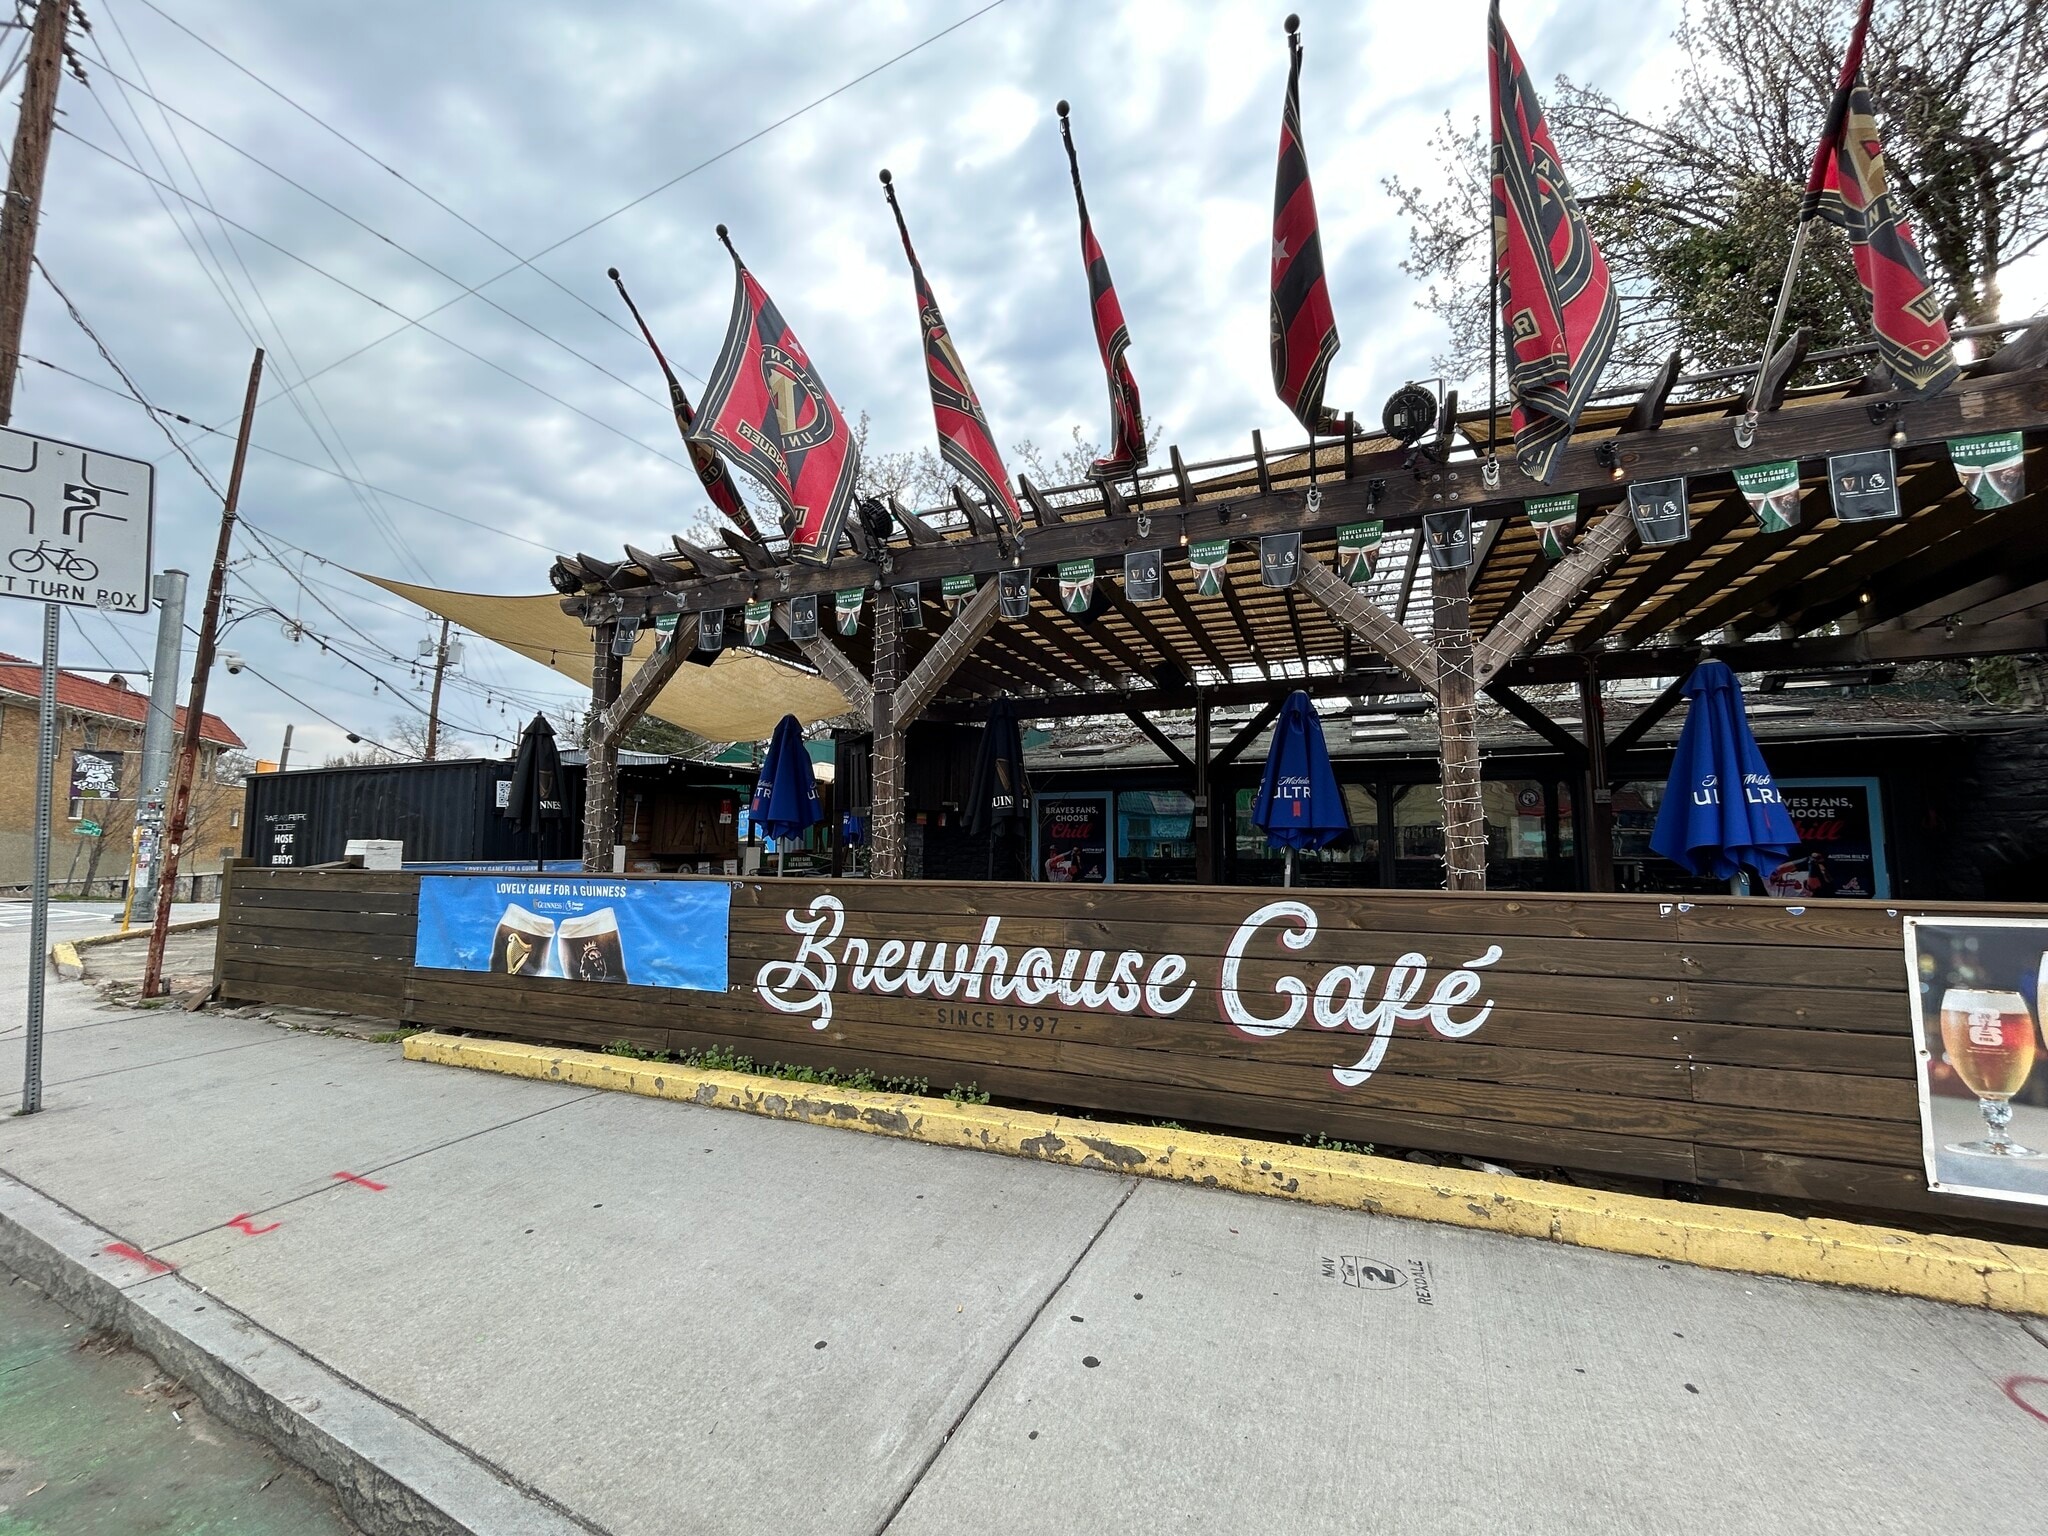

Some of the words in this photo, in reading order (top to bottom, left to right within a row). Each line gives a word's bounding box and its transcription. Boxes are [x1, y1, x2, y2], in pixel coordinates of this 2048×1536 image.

[1976, 445, 2019, 455] GUINNESS
[1740, 472, 1767, 480] LOVELY
[28, 579, 84, 601] TURN
[97, 589, 137, 608] BOX
[1812, 798, 1853, 808] FANS,
[1051, 823, 1091, 838] Chill
[496, 883, 526, 894] LOVELY
[528, 884, 552, 895] GAME
[554, 884, 570, 896] FOR
[572, 885, 578, 896] A
[580, 886, 626, 898] GUINNESS
[753, 893, 1198, 1030] Brewhouse
[1220, 900, 1503, 1087] Café
[937, 1008, 995, 1028] SINCE
[1007, 1013, 1060, 1034] 1997
[1322, 1256, 1335, 1278] NAV
[1362, 1266, 1396, 1285] 2
[1408, 1259, 1434, 1306] REXDALE
